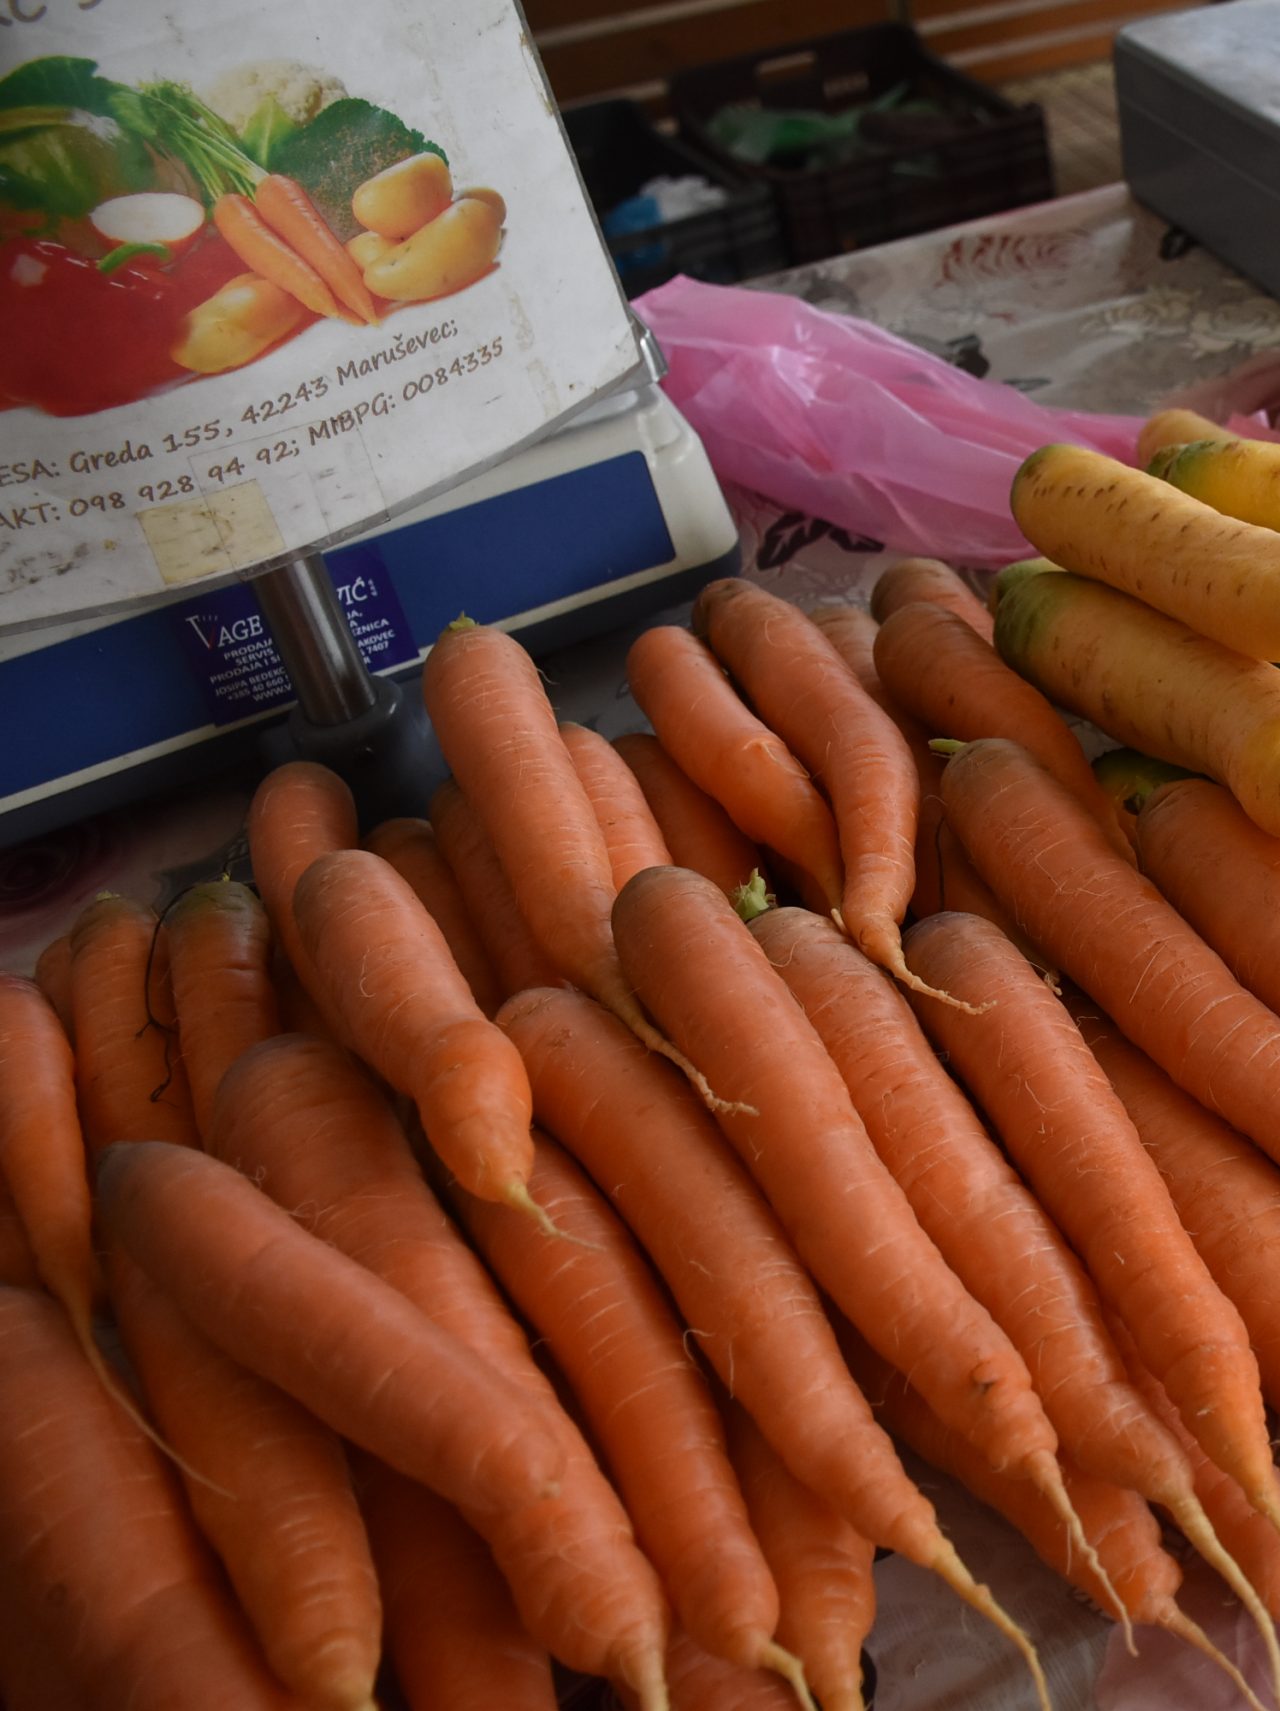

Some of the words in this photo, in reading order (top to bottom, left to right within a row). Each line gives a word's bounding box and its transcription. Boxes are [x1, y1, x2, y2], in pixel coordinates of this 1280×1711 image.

[69, 440, 154, 474] Greda
[164, 419, 234, 453] 155,
[240, 376, 329, 425] 42243
[336, 318, 459, 386] Maruševec;
[69, 492, 126, 518] 098
[138, 474, 196, 503] 928
[207, 455, 245, 484] 94
[256, 437, 300, 466] 92;
[402, 336, 504, 401] 0084335
